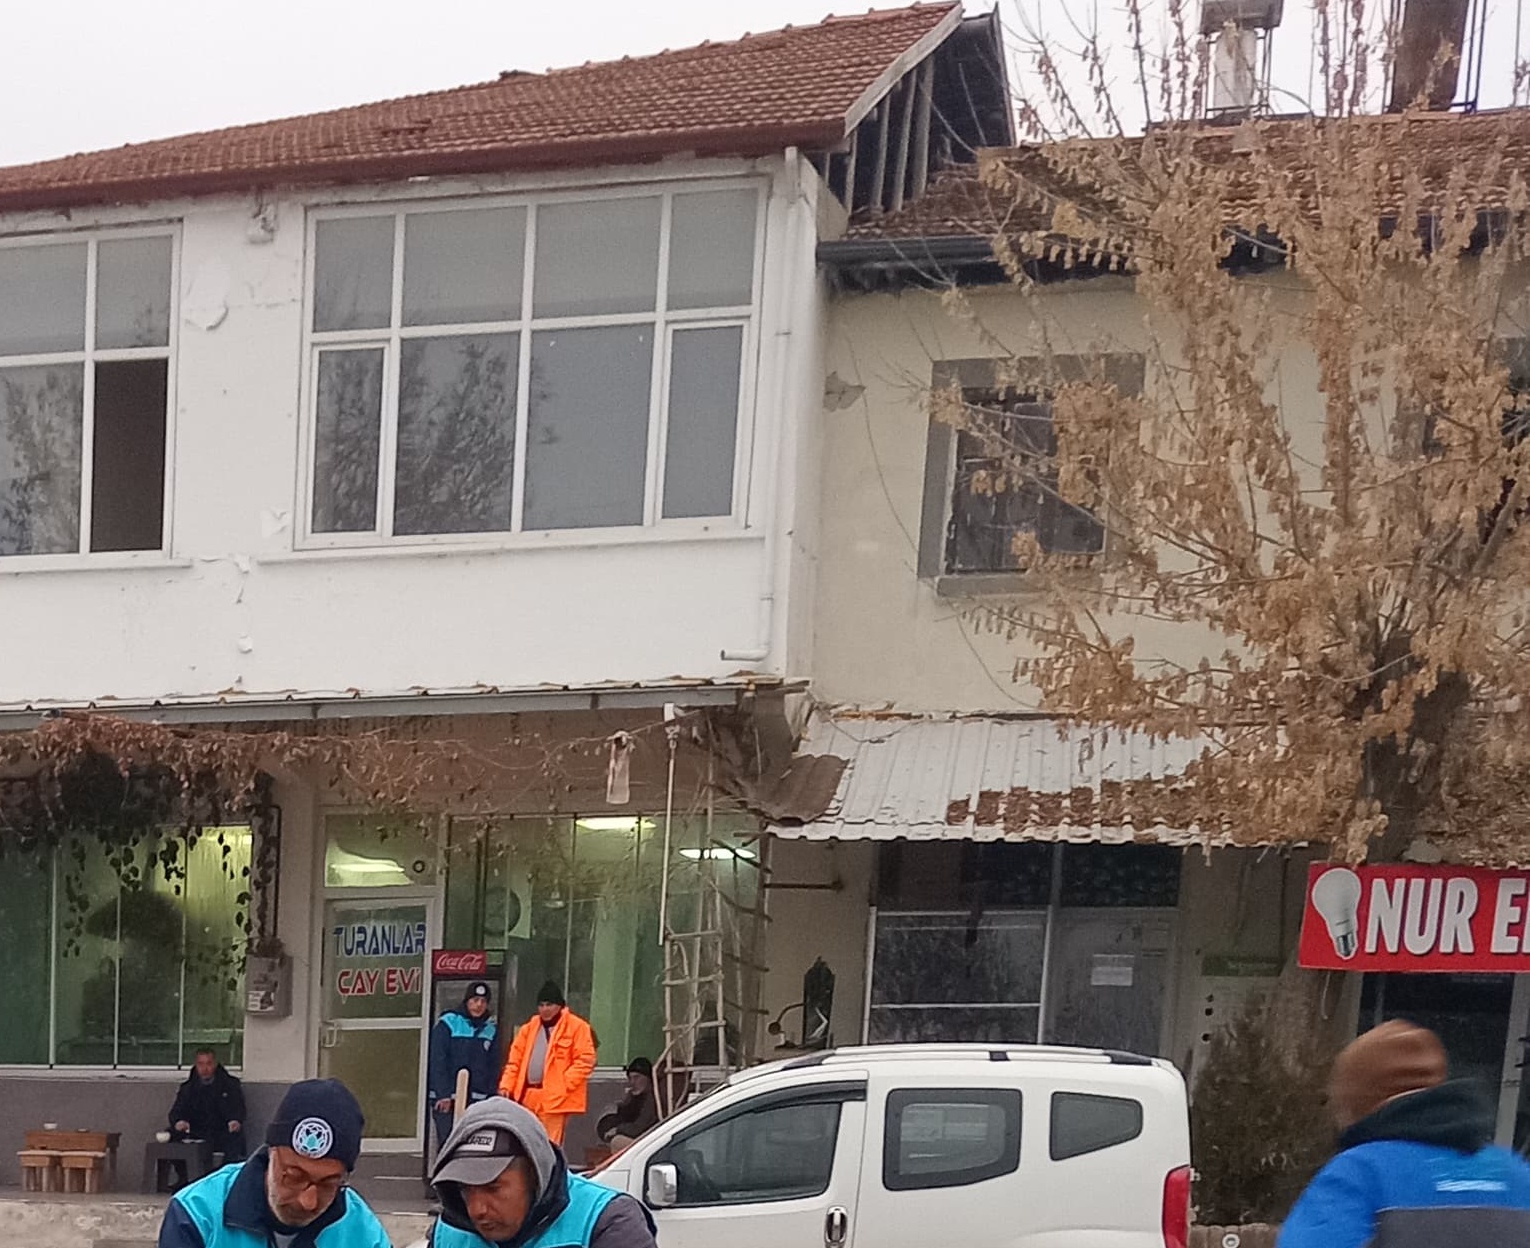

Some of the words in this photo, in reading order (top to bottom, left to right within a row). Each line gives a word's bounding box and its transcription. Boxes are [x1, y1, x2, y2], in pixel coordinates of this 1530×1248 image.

[333, 923, 426, 956] TURANLAR
[1365, 877, 1478, 954] NUR
[1490, 878, 1530, 954] E
